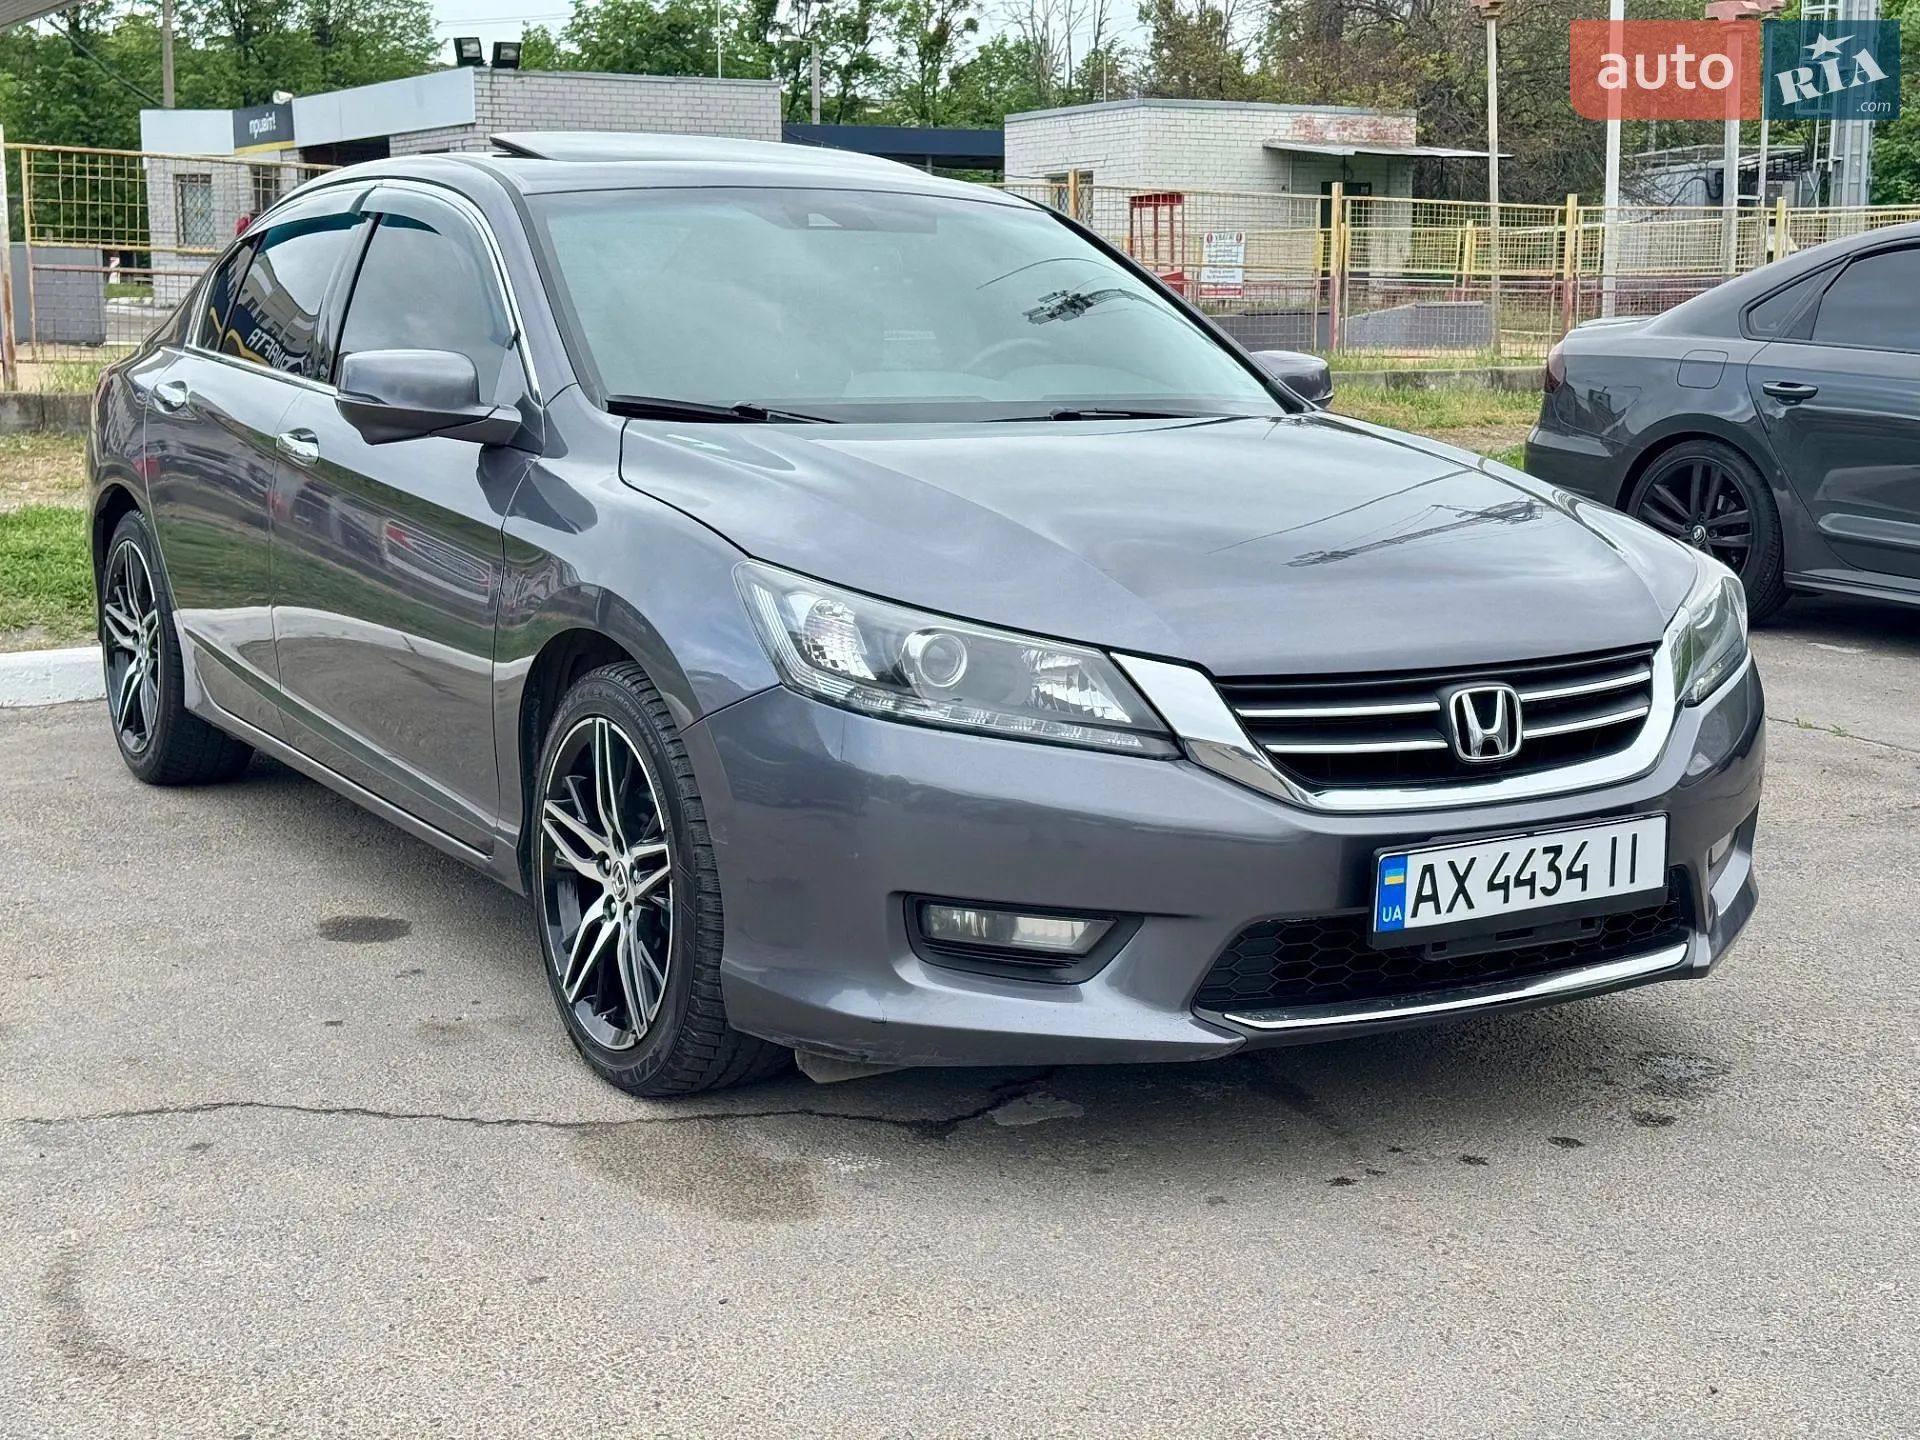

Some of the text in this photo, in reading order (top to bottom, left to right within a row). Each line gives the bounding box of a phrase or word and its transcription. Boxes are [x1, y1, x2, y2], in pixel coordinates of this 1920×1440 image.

[1410, 832, 1638, 919] AX 4434 II
[1382, 905, 1402, 923] UA
